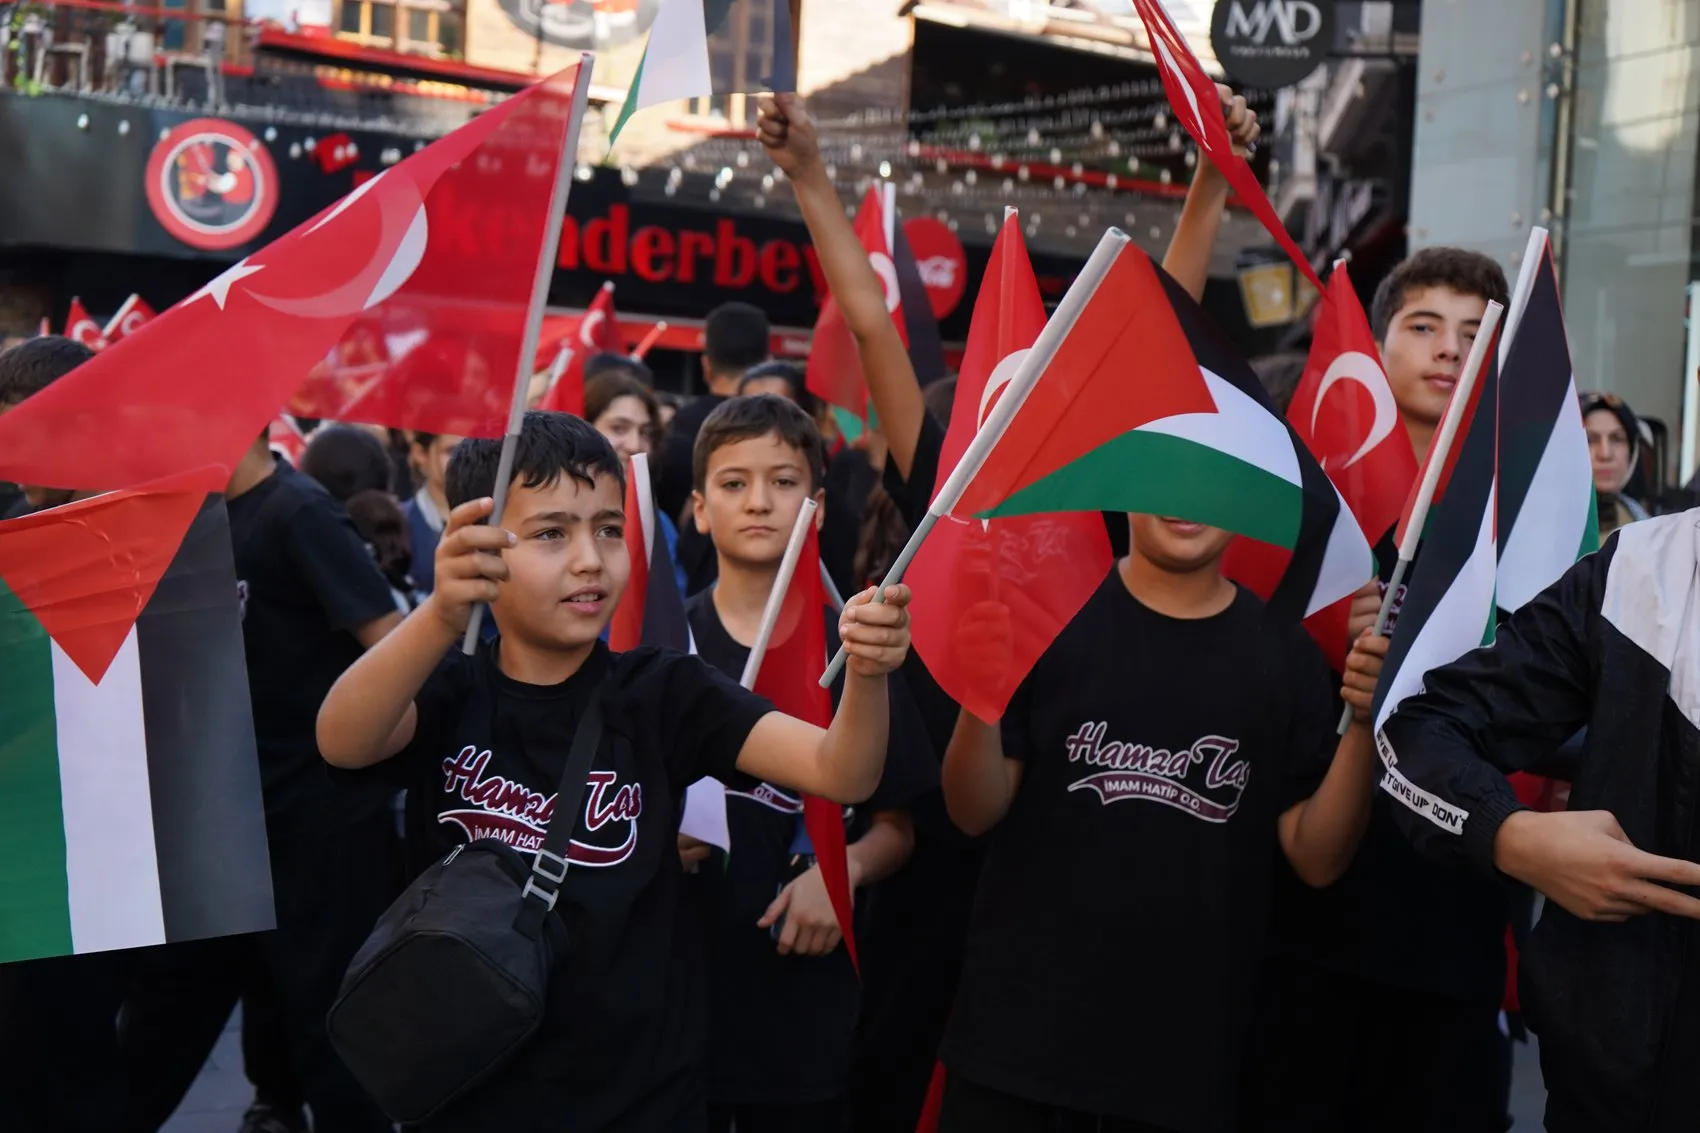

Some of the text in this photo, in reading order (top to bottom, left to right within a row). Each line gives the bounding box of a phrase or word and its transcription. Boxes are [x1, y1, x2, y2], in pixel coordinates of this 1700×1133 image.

[1225, 0, 1321, 44] MAD
[1065, 721, 1191, 778] Hamza
[1103, 779, 1140, 793] İMAM
[1142, 782, 1178, 799] HATİP
[474, 825, 545, 850] İMAM HAT
